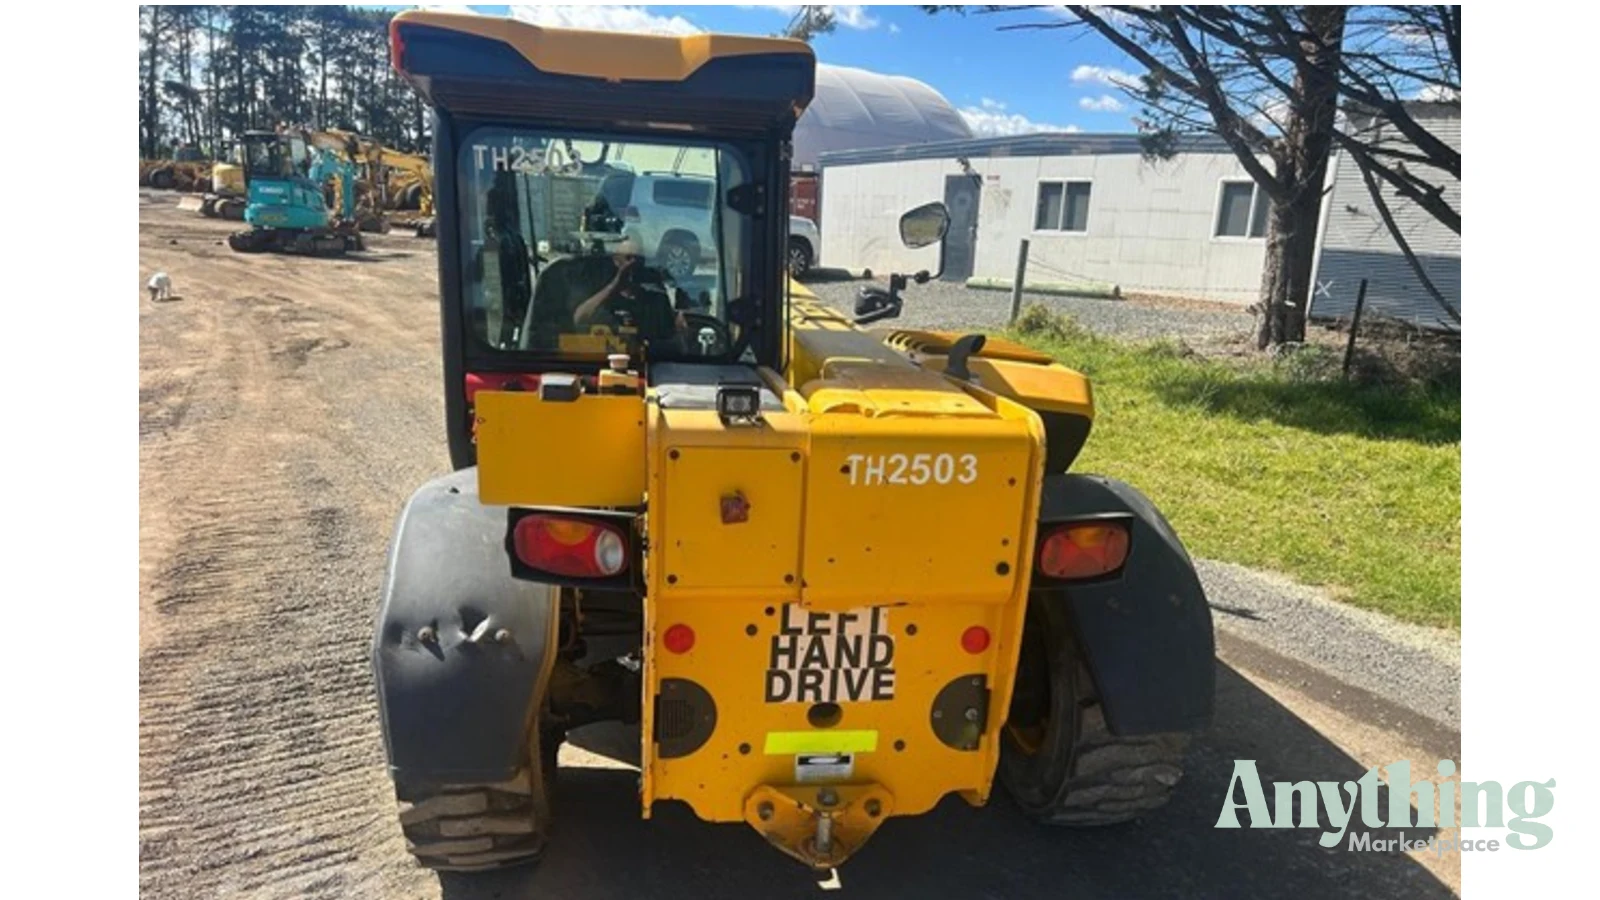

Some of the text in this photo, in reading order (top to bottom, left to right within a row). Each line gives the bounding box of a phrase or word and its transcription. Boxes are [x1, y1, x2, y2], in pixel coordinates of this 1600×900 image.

[472, 145, 583, 175] TH2503
[847, 453, 978, 485] TH2503
[770, 635, 894, 669] HAND
[765, 668, 895, 702] DRIVE
